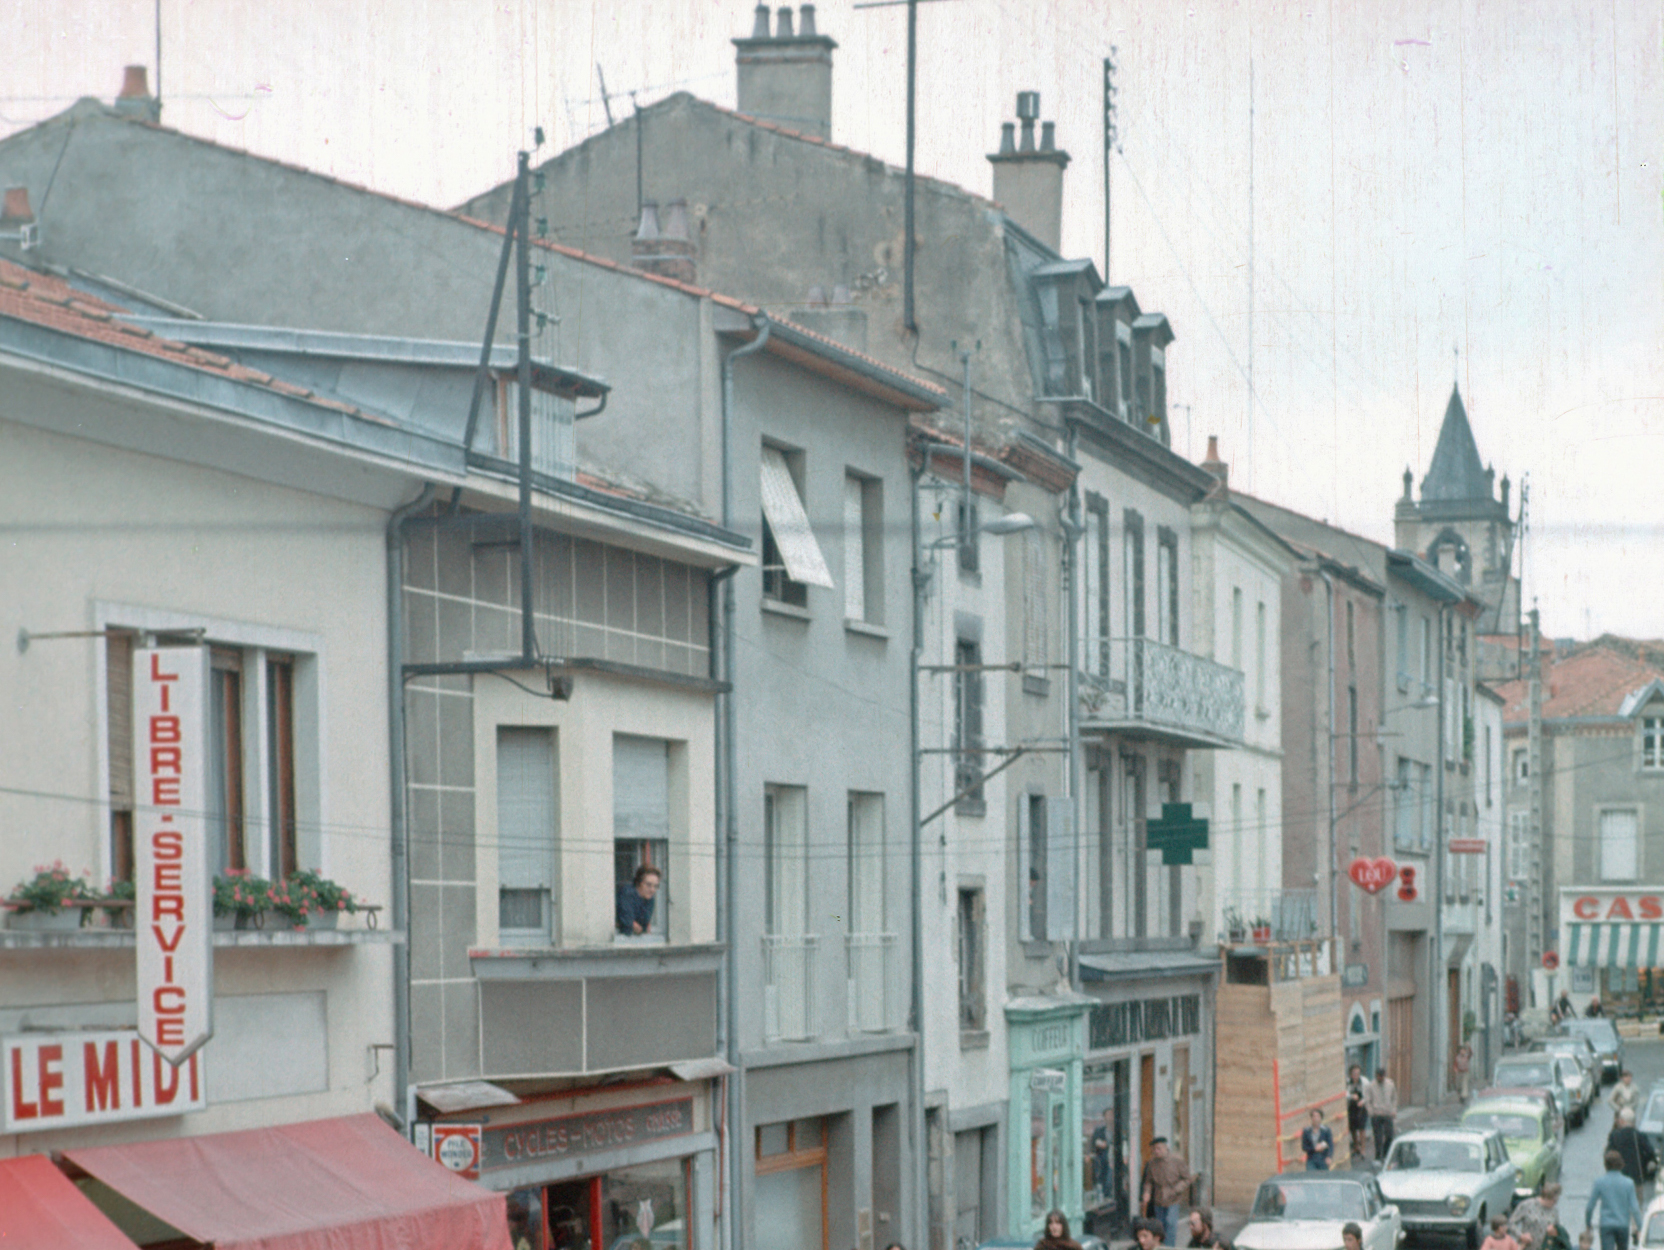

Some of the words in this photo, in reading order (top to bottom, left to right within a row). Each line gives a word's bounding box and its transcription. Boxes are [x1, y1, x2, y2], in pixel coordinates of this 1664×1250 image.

[149, 653, 187, 1047] LIBRE-SERVICE
[12, 1045, 65, 1120] LE
[84, 1039, 199, 1113] MIDI
